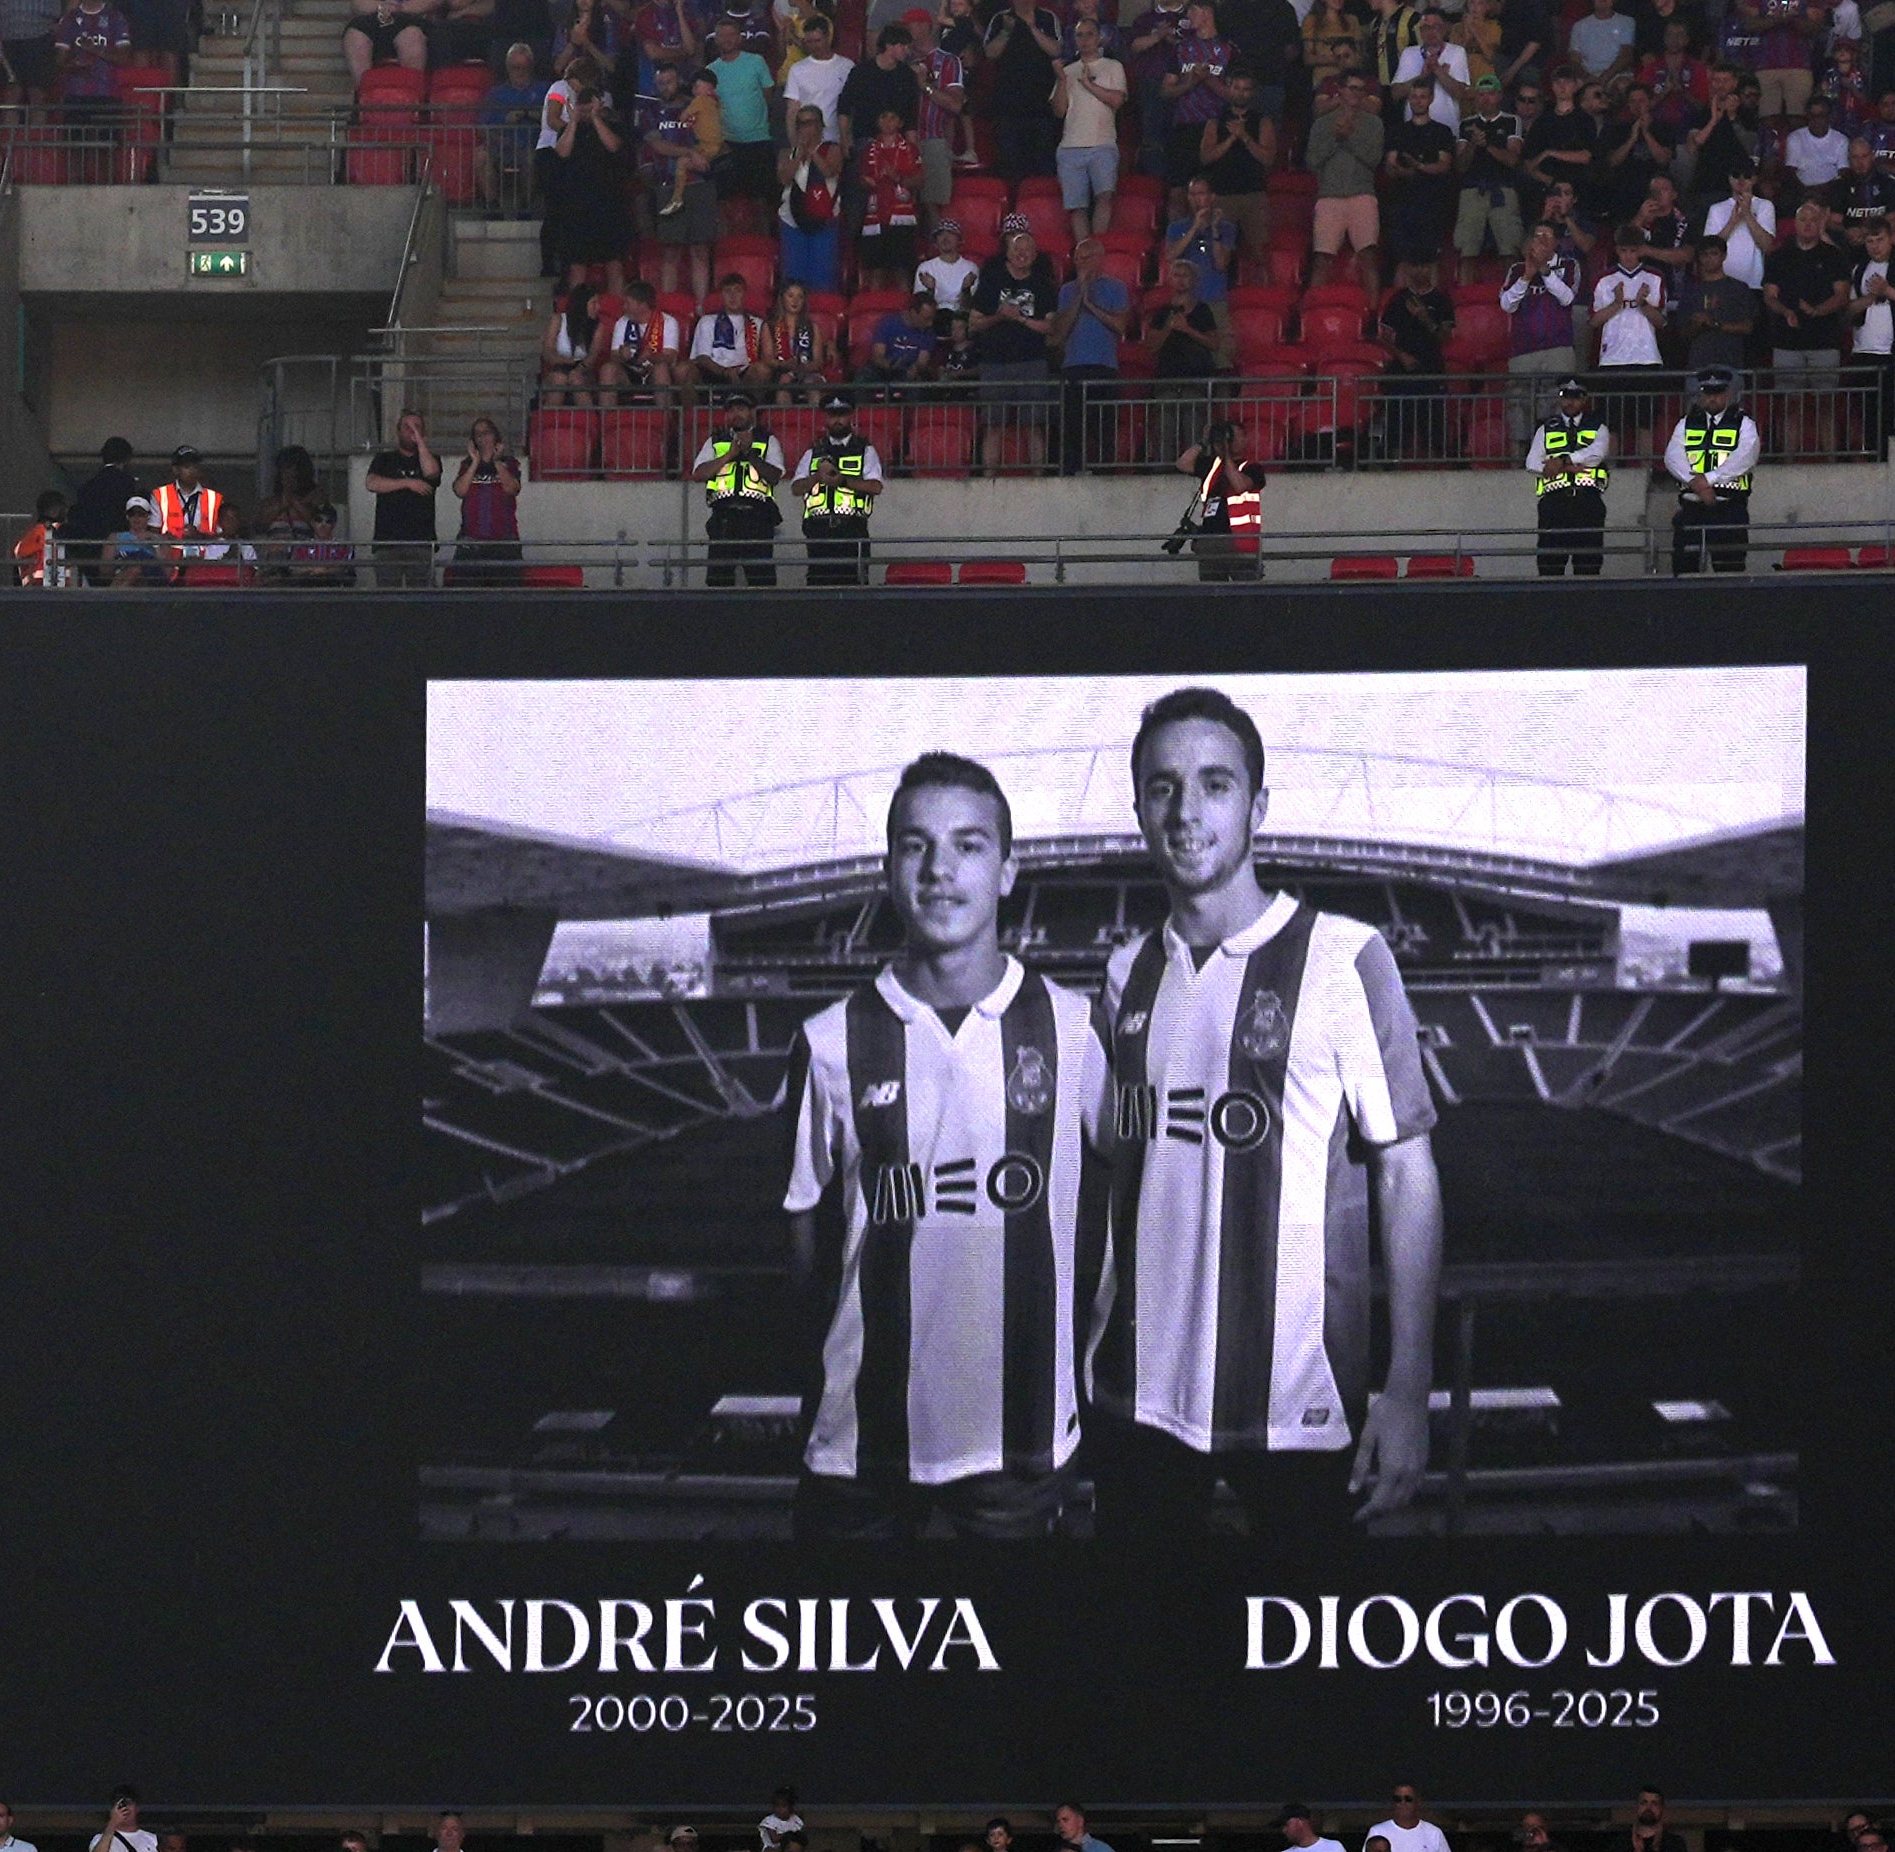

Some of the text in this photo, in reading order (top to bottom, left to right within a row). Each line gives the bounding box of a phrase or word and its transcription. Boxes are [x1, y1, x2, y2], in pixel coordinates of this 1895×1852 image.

[192, 209, 245, 234] 539
[374, 1574, 1000, 1672] ANDRÉ SILVA
[1245, 1592, 1835, 1669] DIOGO JOTA
[570, 1695, 817, 1732] 2000-2025
[1428, 1690, 1660, 1728] 1996-2025
